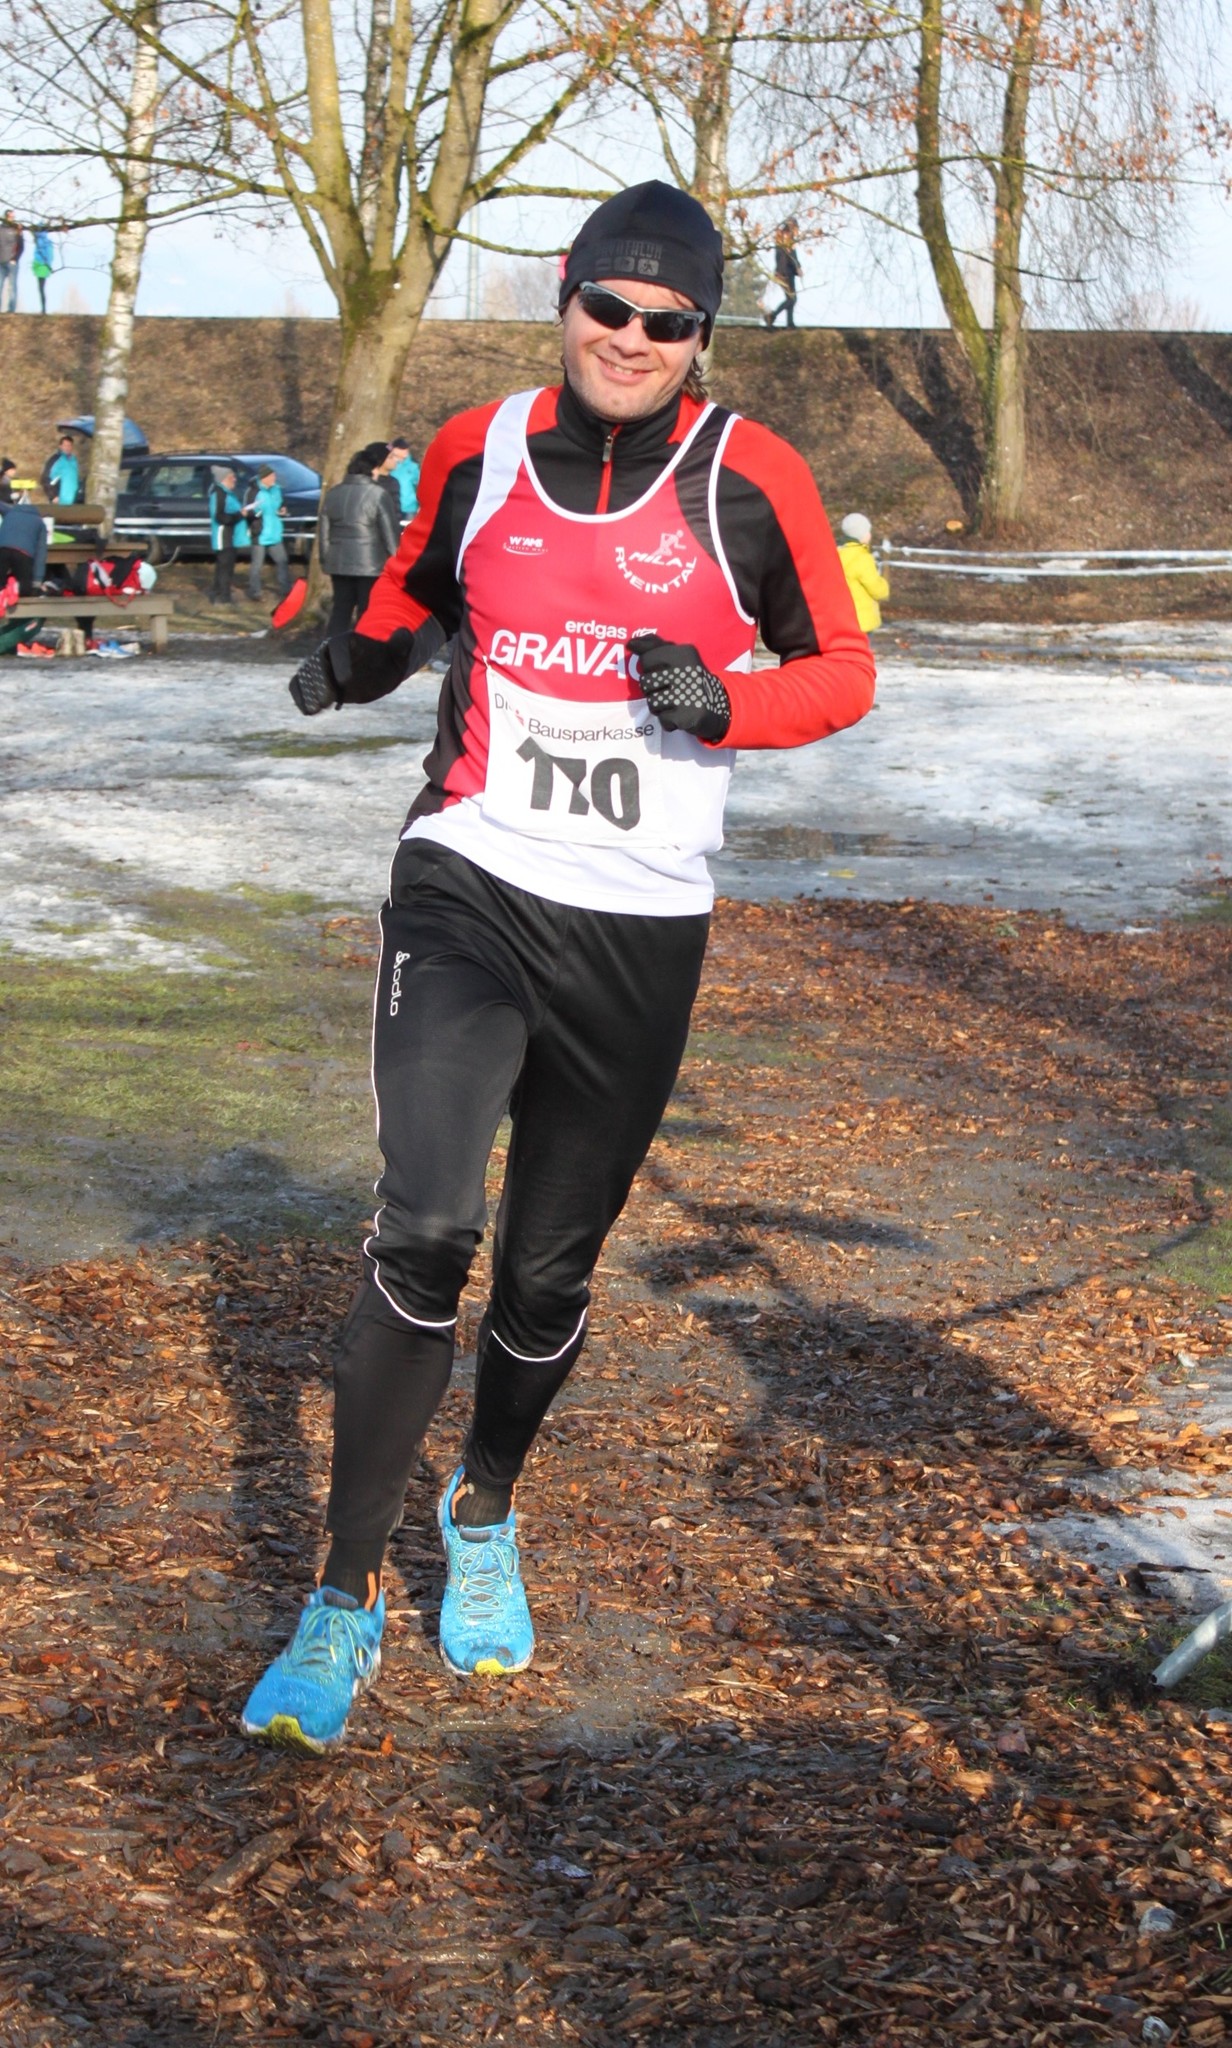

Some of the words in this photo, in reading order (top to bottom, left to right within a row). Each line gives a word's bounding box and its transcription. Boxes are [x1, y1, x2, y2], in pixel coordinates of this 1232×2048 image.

[615, 546, 697, 594] RHEINTAL
[628, 551, 683, 568] MILA
[565, 619, 627, 640] erdgas
[528, 717, 655, 743] Bausparkasse
